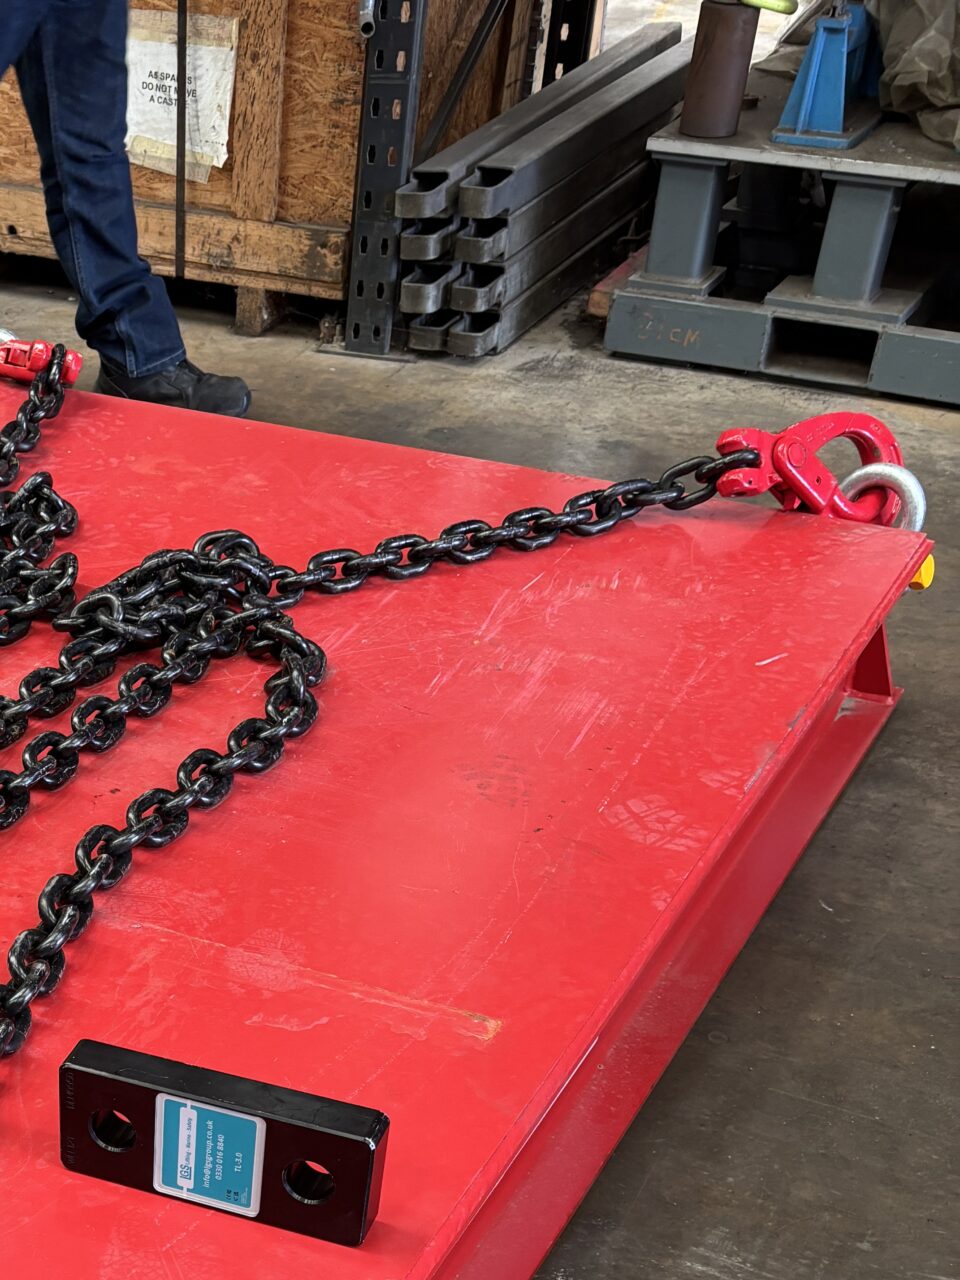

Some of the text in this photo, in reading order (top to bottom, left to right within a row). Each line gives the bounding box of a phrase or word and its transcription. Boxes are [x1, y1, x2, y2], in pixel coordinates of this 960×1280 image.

[160, 72, 192, 85] SPAS
[141, 81, 154, 91] DO
[155, 83, 172, 93] NOT
[149, 94, 155, 103] A
